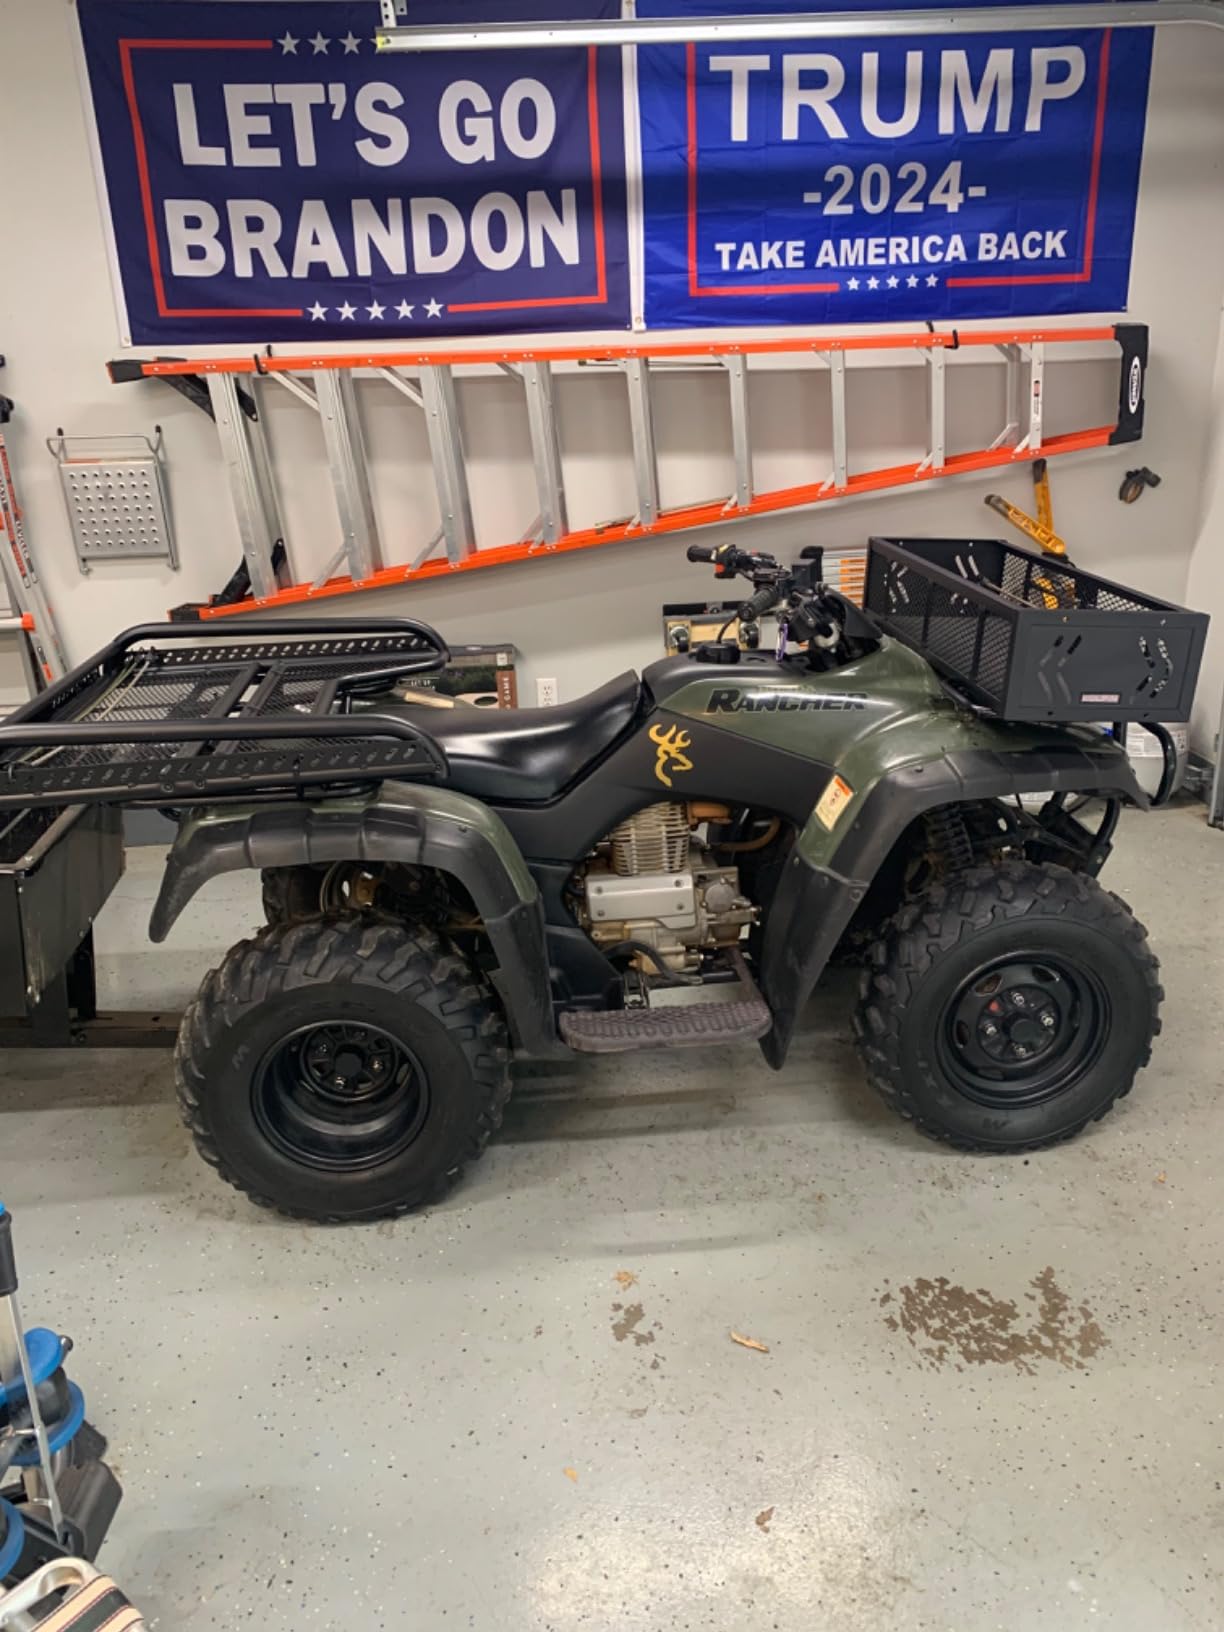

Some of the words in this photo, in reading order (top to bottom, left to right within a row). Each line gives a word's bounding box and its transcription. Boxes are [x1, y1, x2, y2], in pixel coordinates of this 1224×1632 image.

[173, 82, 409, 167] LET'S
[439, 78, 556, 164] GO
[709, 46, 1085, 142] TRUMP
[804, 161, 986, 215] -2024-
[164, 189, 580, 278] BRANDON
[715, 240, 805, 271] TAKE
[815, 234, 967, 267] AMERICA
[978, 230, 1067, 261] BACK
